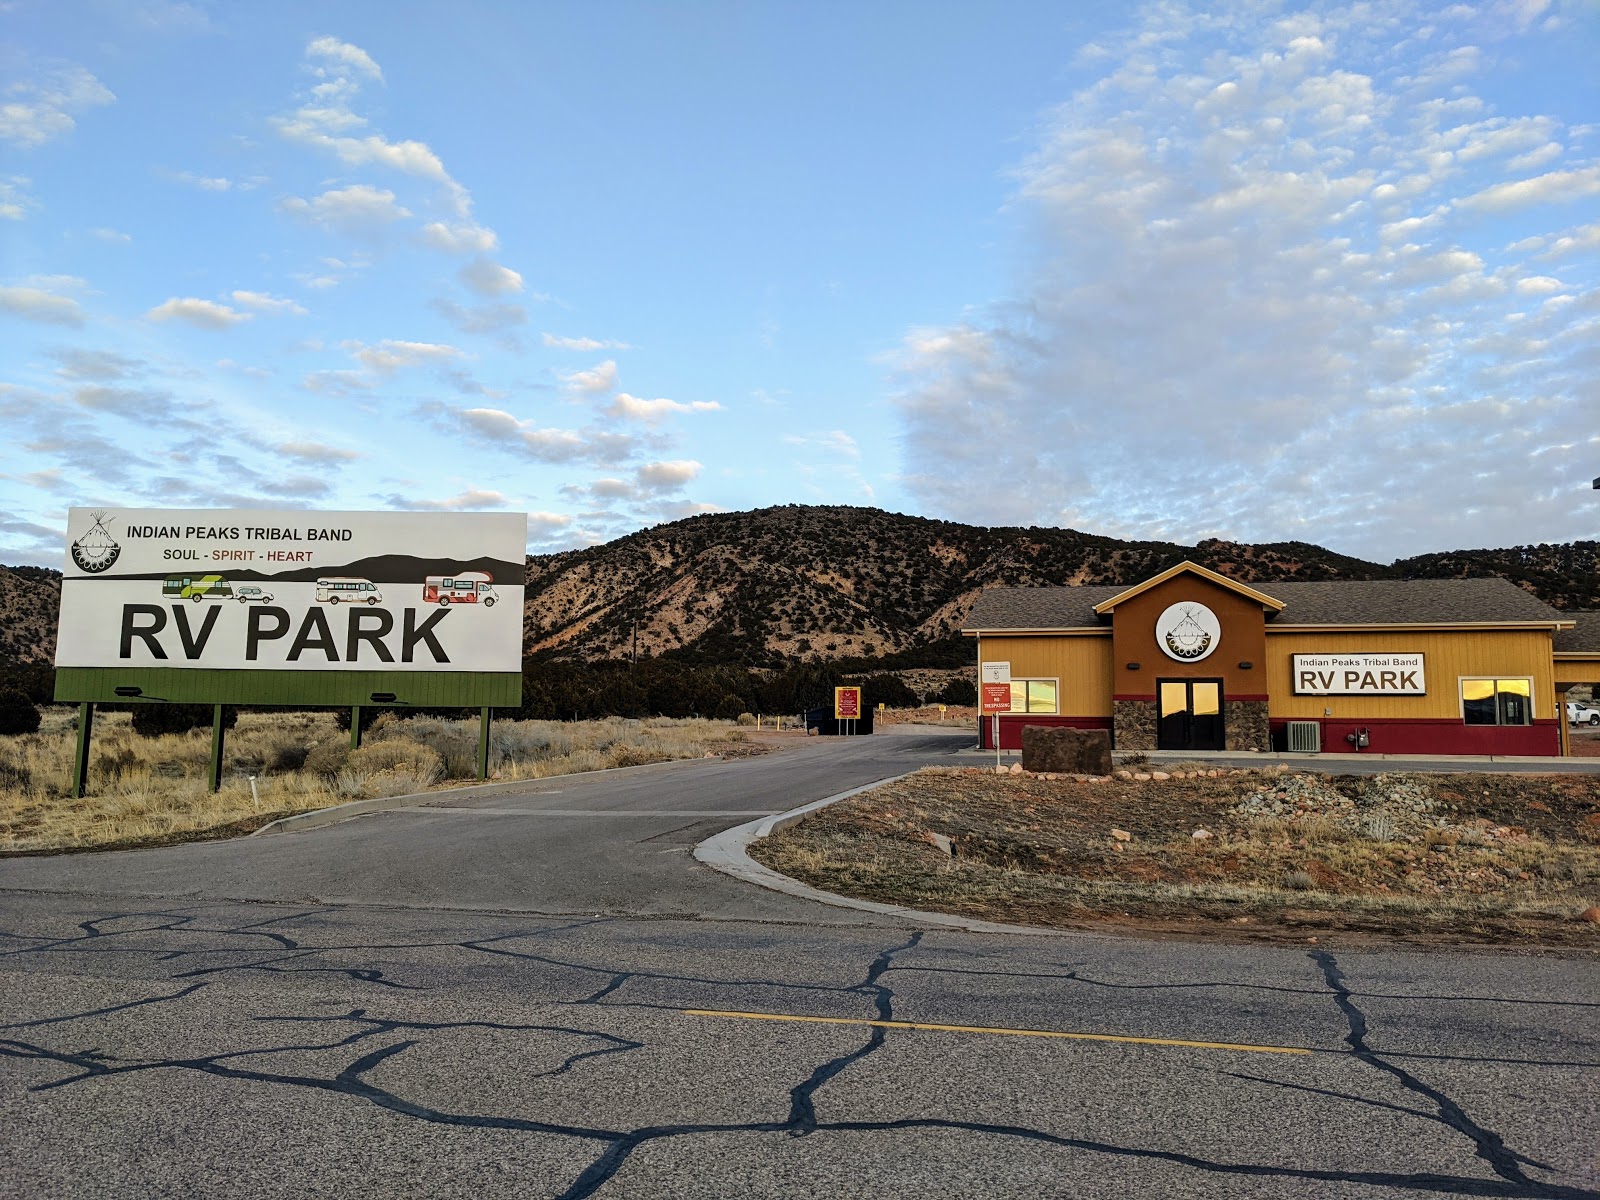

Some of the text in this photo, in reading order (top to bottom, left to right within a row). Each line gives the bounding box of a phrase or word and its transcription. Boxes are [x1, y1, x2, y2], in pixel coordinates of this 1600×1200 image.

[127, 525, 353, 542] INDIAN PEAKS TRIBAL BAND
[163, 548, 200, 561] SOUL
[211, 549, 256, 562] SPIRIT
[267, 550, 314, 563] HEART
[120, 603, 453, 664] RV PARK
[1300, 657, 1419, 667] Indian Peaks Tribal Band
[1300, 670, 1419, 690] RV PARK
